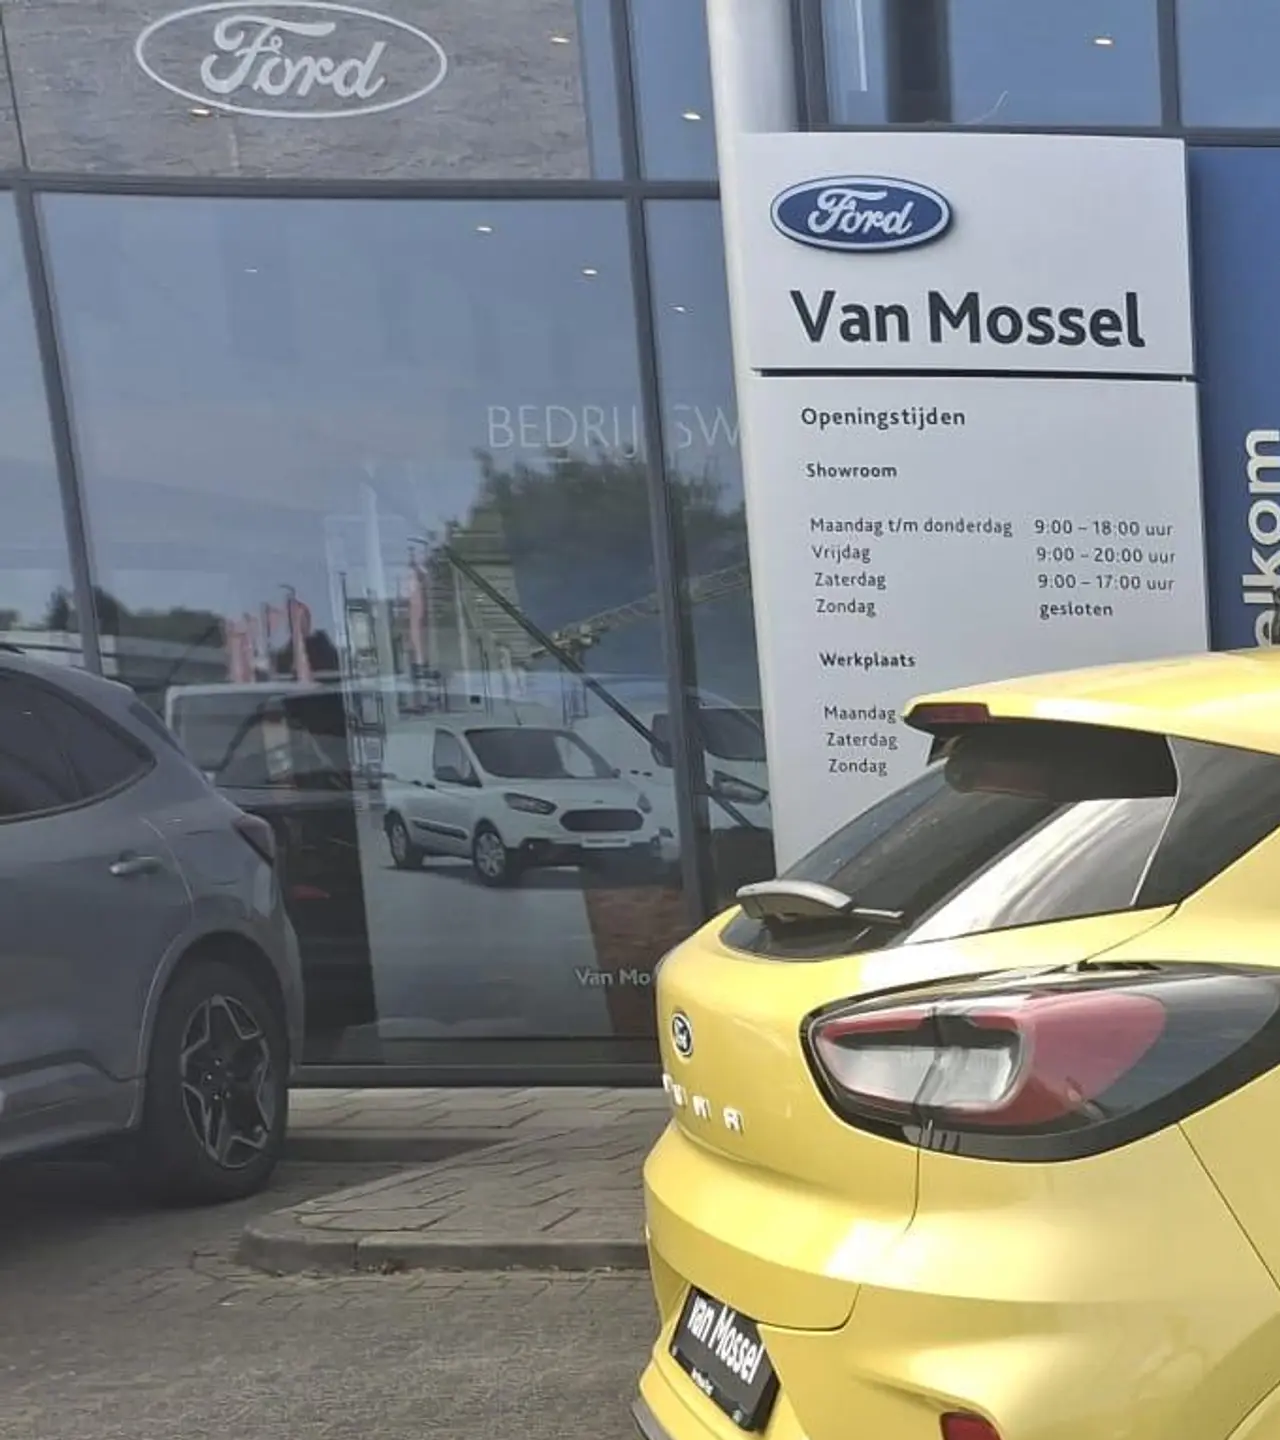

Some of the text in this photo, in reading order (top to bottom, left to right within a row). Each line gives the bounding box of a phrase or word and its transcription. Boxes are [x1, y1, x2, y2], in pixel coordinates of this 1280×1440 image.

[200, 14, 387, 99] Ford
[806, 187, 914, 236] Ford
[790, 290, 1145, 347] Van Mossel
[801, 406, 966, 431] Openingstijden
[487, 405, 742, 459] BEDRIJSW
[806, 461, 898, 478] Showroom
[810, 517, 884, 537] Maandag
[888, 517, 919, 533] t/m
[923, 517, 1014, 538] donderdag
[1034, 519, 1073, 534] 9:00
[1092, 520, 1140, 536] 18:00
[1145, 525, 1174, 537] uur
[811, 544, 872, 564] Vrijdag
[1036, 546, 1075, 562] 9:00
[1093, 547, 1144, 563] 20:00
[1148, 552, 1176, 565] uur
[814, 571, 887, 591] Zaterdag
[1037, 573, 1077, 589] 9:00
[1095, 574, 1142, 590] 17:00
[1146, 579, 1176, 591] uur
[815, 598, 1114, 620] Zondag gesloten
[819, 651, 916, 671] Werkplaats
[824, 704, 897, 724] Maandag
[826, 732, 899, 751] Zaterdag
[828, 758, 888, 777] Zondag
[574, 968, 614, 986] Van
[708, 1303, 766, 1386] Mossel
